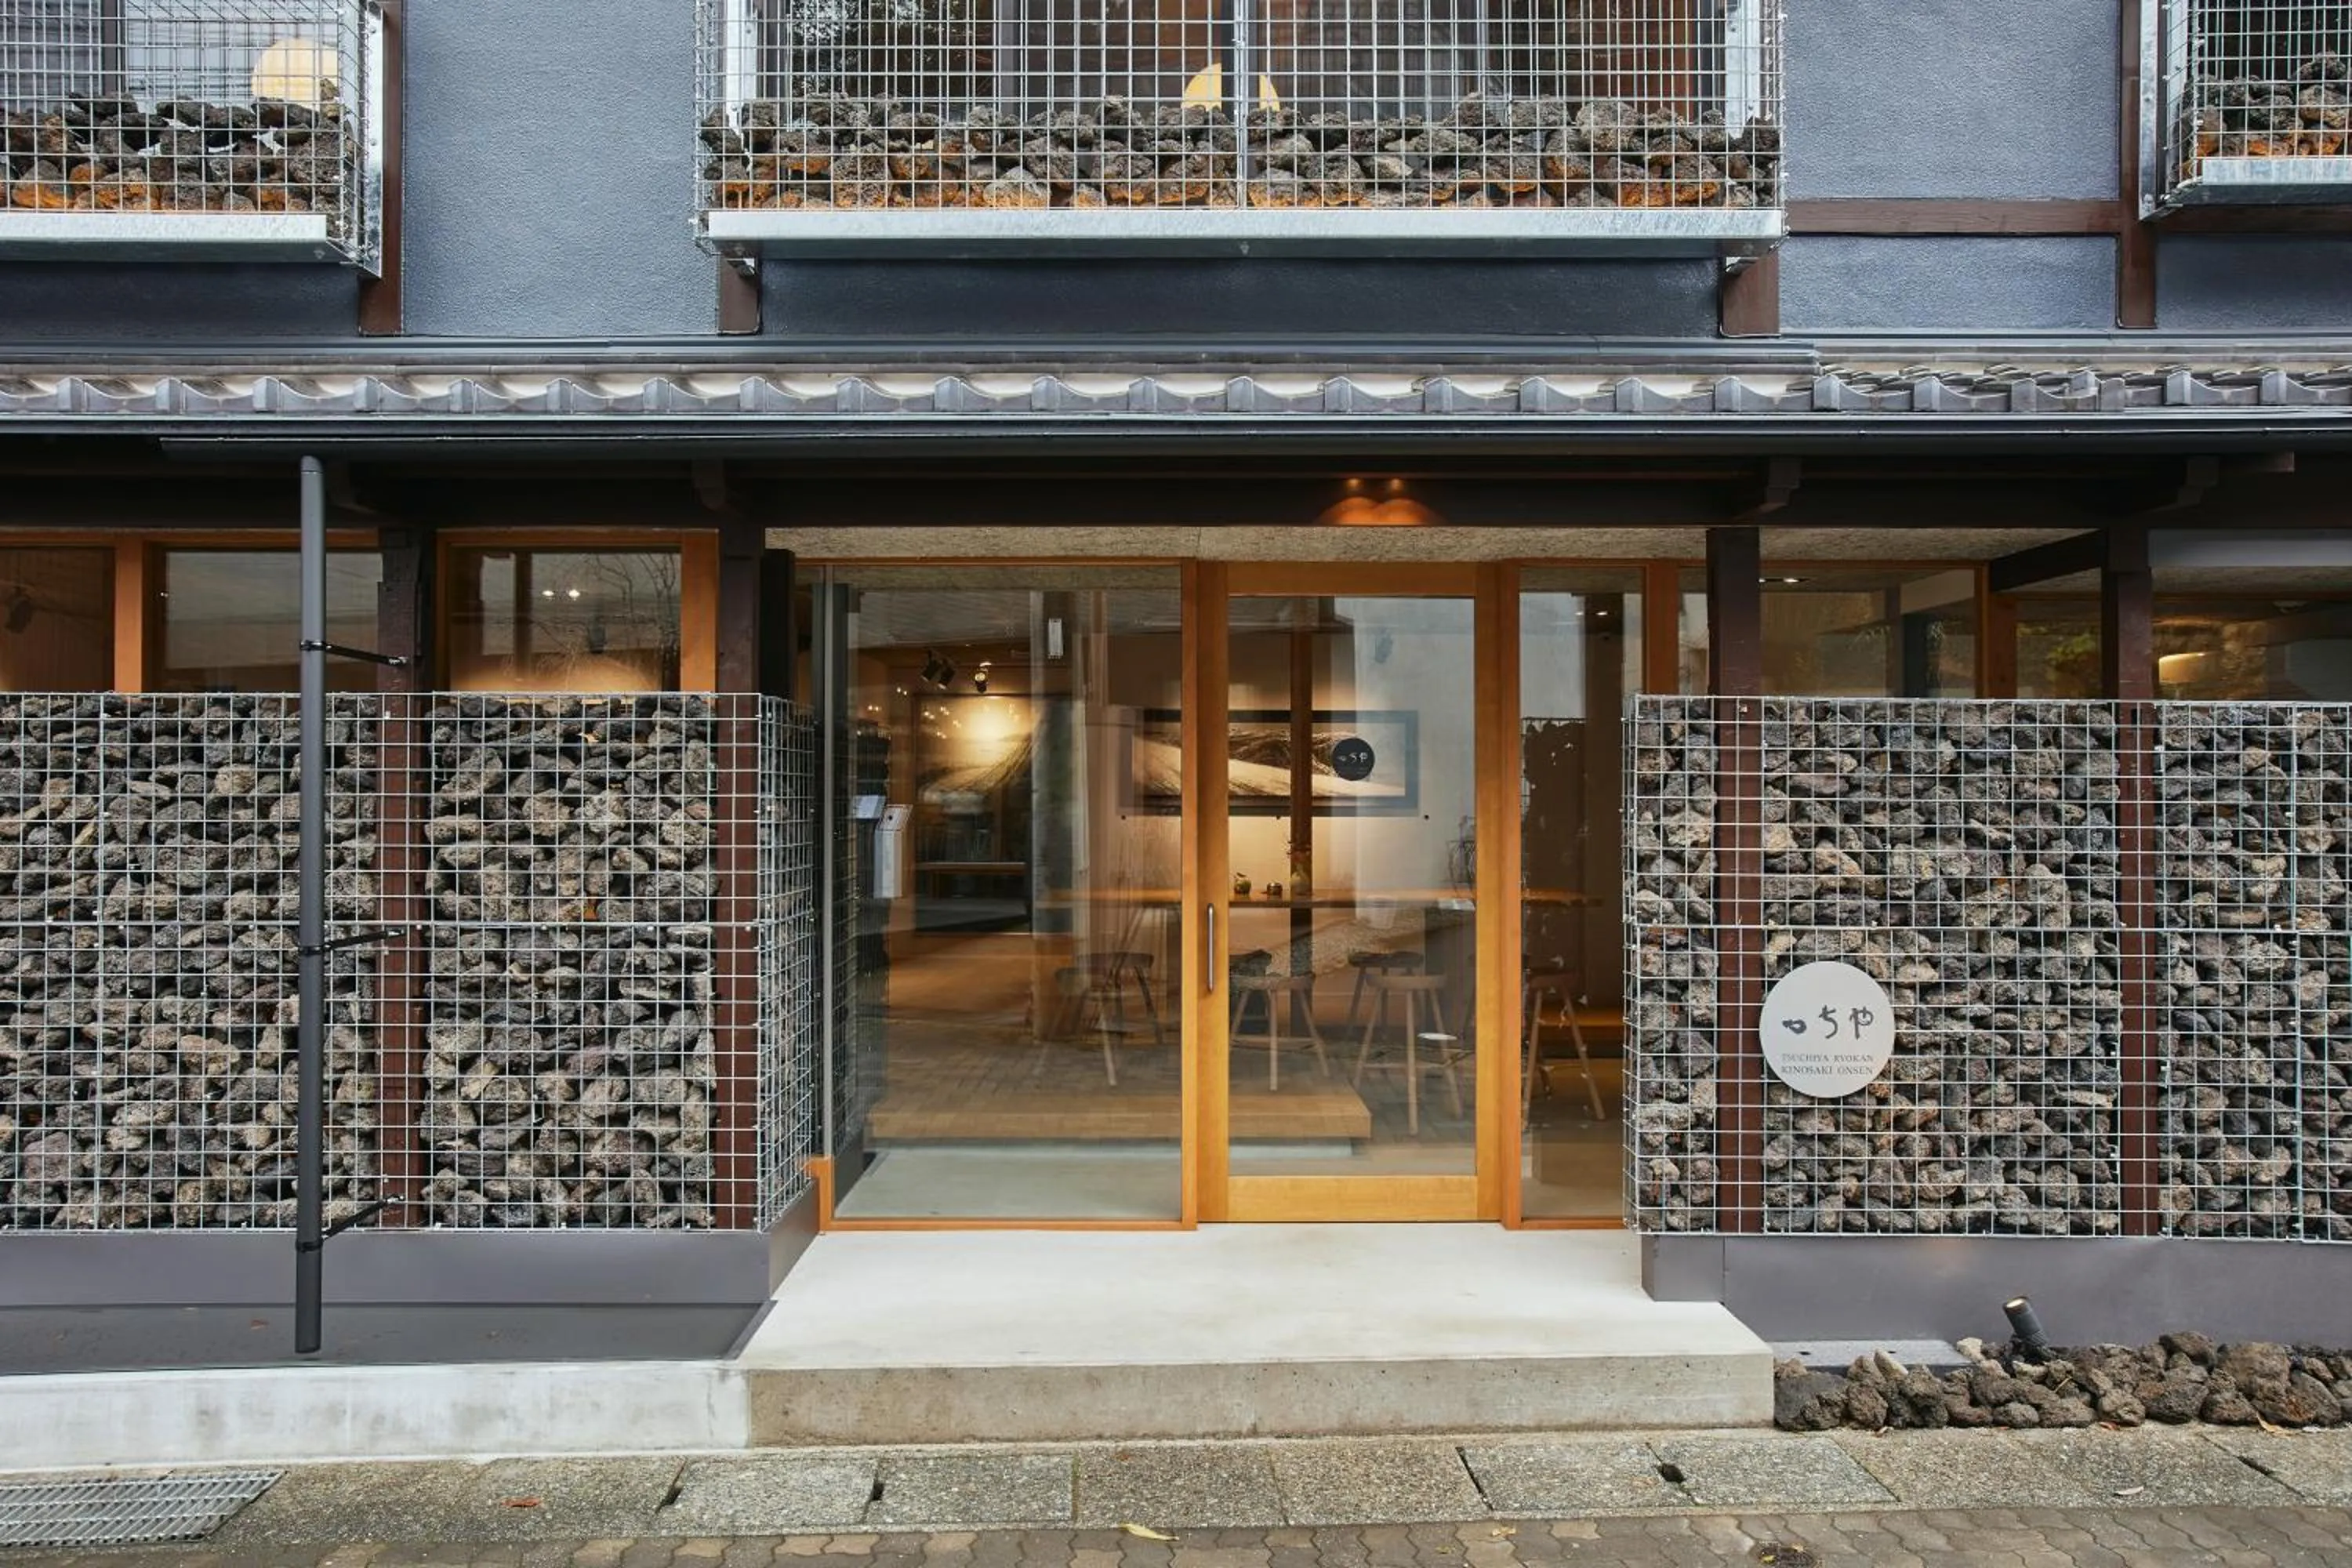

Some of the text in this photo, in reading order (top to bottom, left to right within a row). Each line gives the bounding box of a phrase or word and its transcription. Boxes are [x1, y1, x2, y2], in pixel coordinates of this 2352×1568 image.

[1781, 1053, 1875, 1062] TSUCHIYA RYOKAN
[1781, 1065, 1873, 1075] KINOSAKI ONSEN
